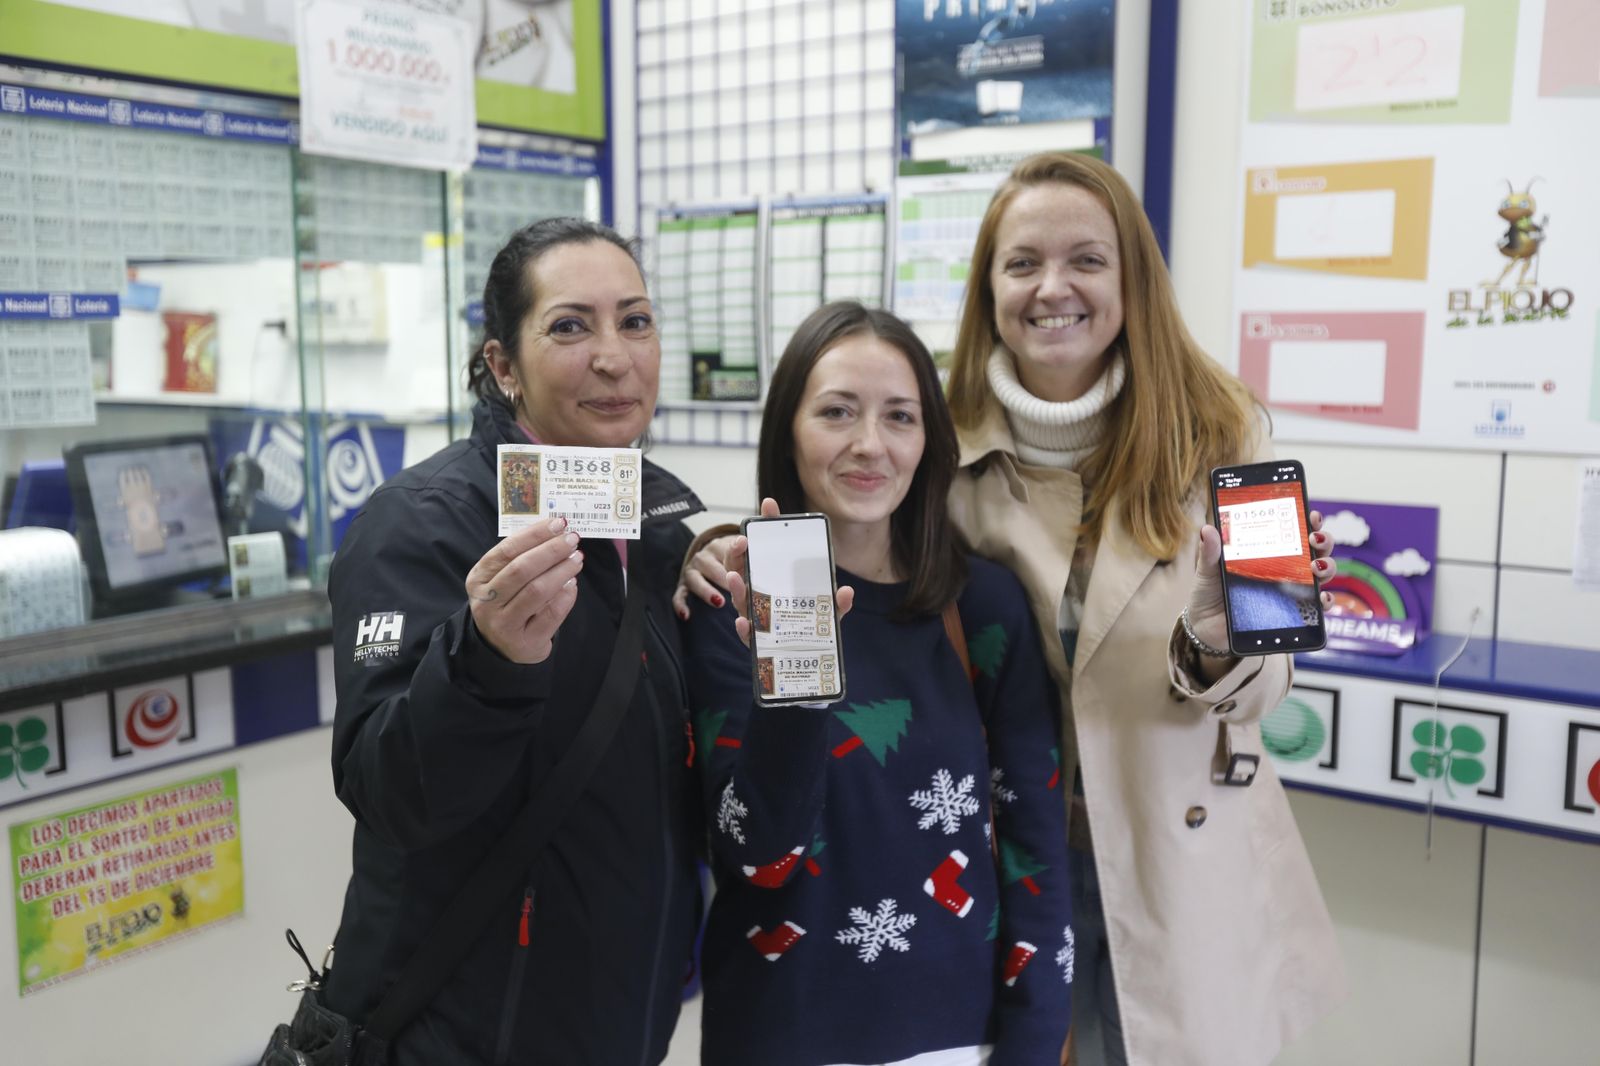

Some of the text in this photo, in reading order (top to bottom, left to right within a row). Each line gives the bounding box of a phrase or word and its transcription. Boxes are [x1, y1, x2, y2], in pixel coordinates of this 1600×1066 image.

[66, 99, 107, 118] Nacional
[5, 298, 48, 313] Nacional
[546, 459, 611, 473] 01568
[649, 500, 690, 517] HANSEN
[775, 598, 815, 608] 01568
[356, 615, 404, 646] HH
[354, 646, 373, 657] HELLY
[779, 659, 819, 667] 11300
[31, 777, 224, 847] LOS DECIMOS APARTADOS
[18, 799, 235, 876] PARA EL SORTEO DE NAVIDAD
[20, 821, 237, 904] DEBERAN RETIRARLOS ANTES
[51, 893, 83, 919] DEL
[110, 879, 131, 901] DE
[134, 852, 215, 892] DICIEMBRE
